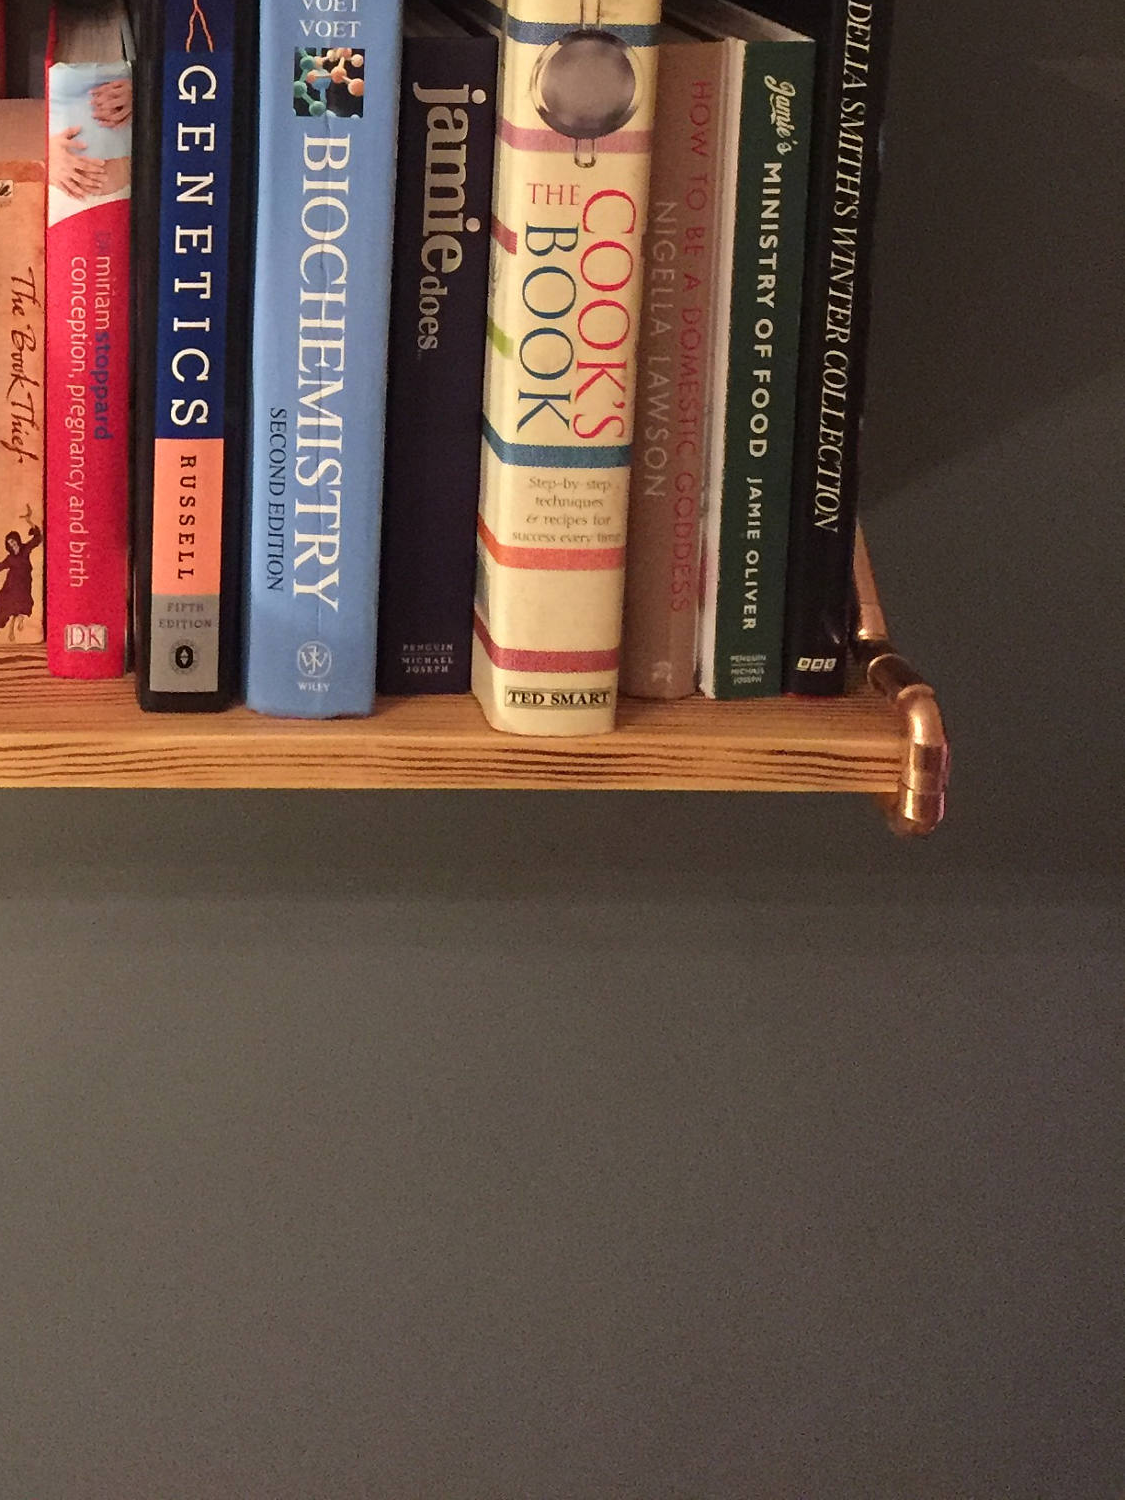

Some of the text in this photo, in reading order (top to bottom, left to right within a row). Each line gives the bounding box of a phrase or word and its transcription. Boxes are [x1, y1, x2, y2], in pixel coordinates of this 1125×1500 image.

[299, 20, 361, 38] VOET
[527, 182, 581, 206] THE
[757, 162, 782, 309] MINISTRY
[171, 64, 218, 426] GENETICS
[813, 0, 873, 533] DELIA SMITH'S WINTER COLLECTION
[516, 221, 580, 433] BOOK
[573, 189, 637, 439] COOK'S
[752, 318, 774, 358] OF
[292, 133, 352, 613] BIOCHEMISTRY
[749, 369, 771, 458] FOOD
[65, 256, 92, 588] conception, pregnancy and birth
[178, 455, 197, 580] RUSSELL
[266, 407, 286, 592] SECOND EDITION
[746, 476, 763, 540] JAMIE
[158, 618, 212, 629] EDITION
[166, 602, 204, 612] FIFTH
[742, 550, 760, 630] OLIVER
[69, 627, 104, 645] DK
[297, 682, 331, 693] WILEY
[508, 689, 612, 706] TED SMART
